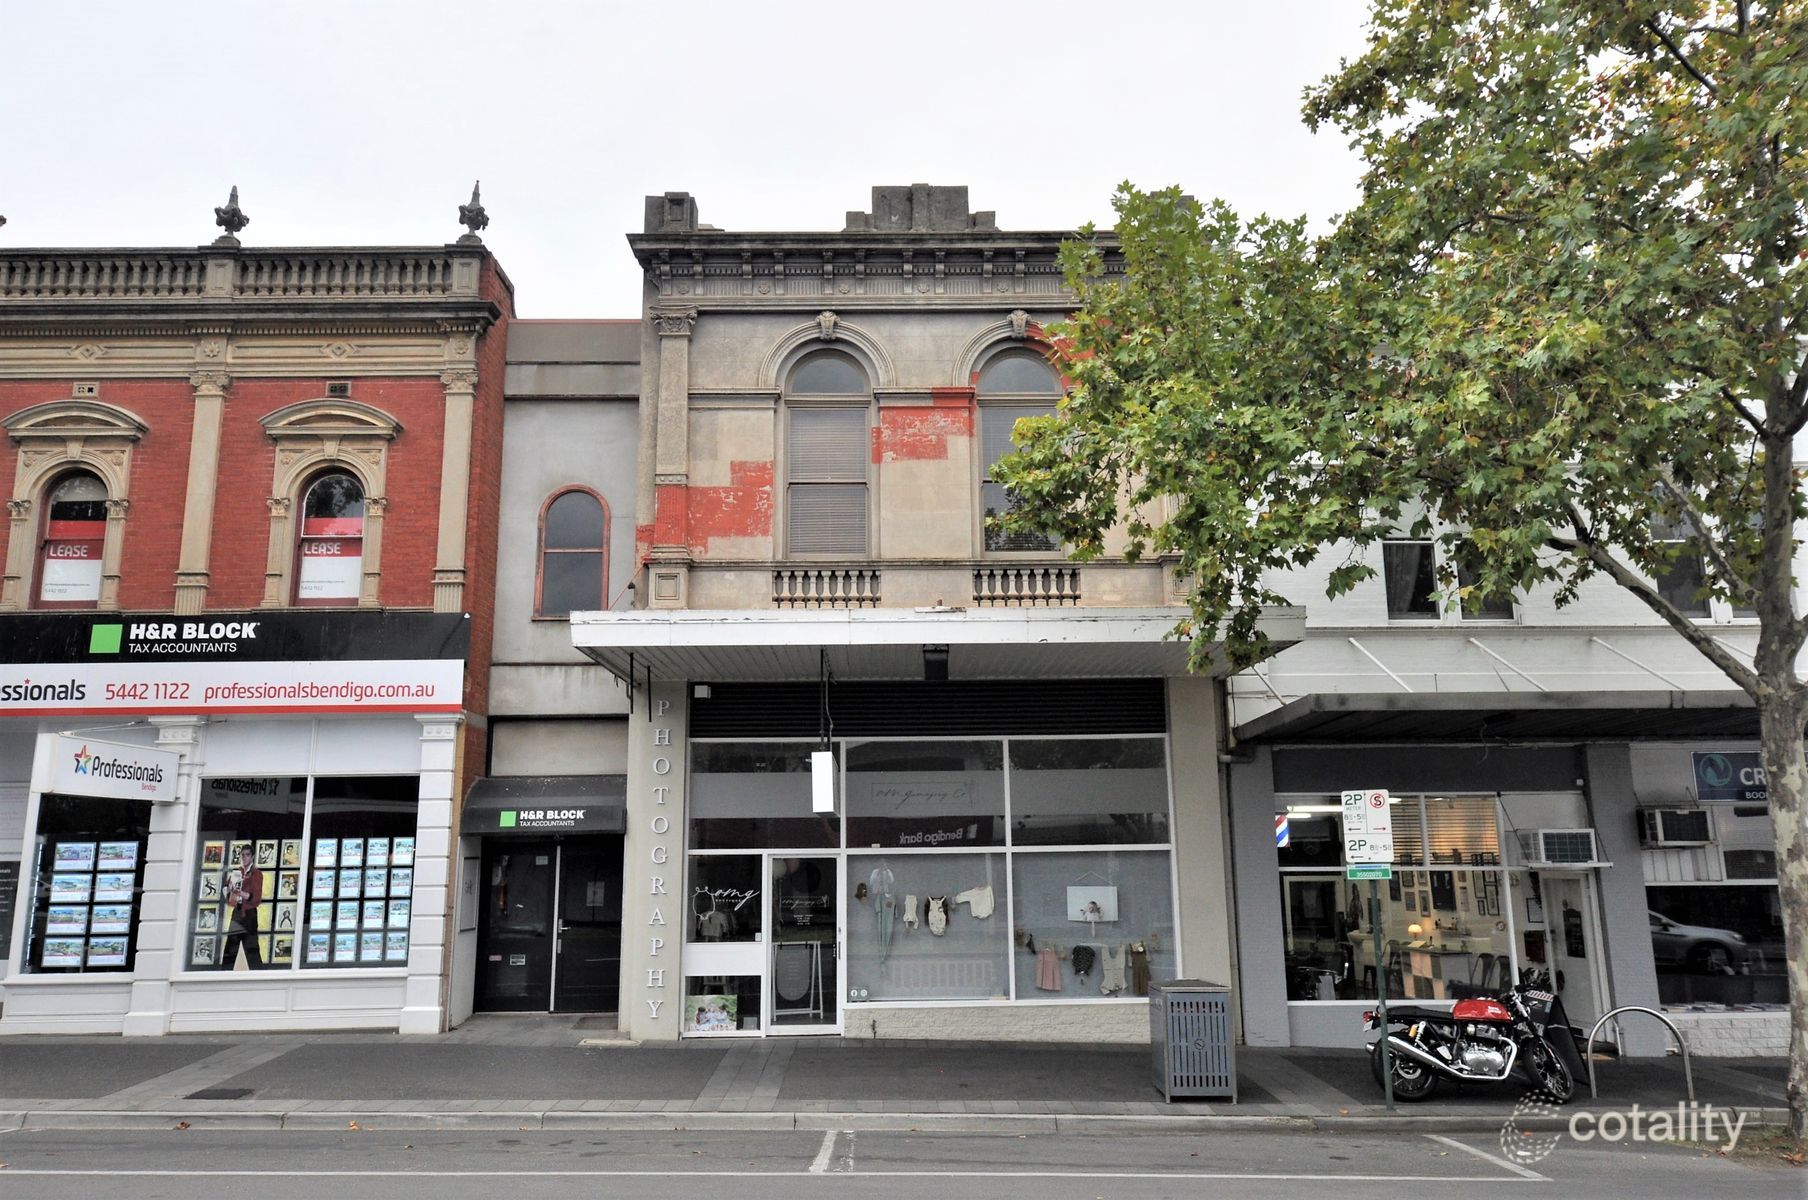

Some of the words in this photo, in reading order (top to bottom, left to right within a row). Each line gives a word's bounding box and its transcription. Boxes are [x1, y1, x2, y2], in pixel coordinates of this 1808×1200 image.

[50, 545, 88, 557] LEASE
[304, 542, 341, 554] LEASE
[129, 623, 177, 640] H&R
[183, 622, 257, 639] BLOCK
[129, 643, 150, 653] TAX
[151, 643, 237, 653] ACCOUNTANTS
[0, 679, 86, 701] ssionals
[105, 683, 149, 700] 5442
[153, 682, 191, 700] 1122
[204, 682, 435, 703] professionalsbendigo.com.au
[91, 756, 163, 783] Professionals
[1344, 794, 1363, 805] 2P
[1745, 791, 1768, 799] BOO
[520, 810, 544, 820] H&R
[546, 810, 585, 819] BLOCK
[1348, 839, 1367, 851] 2P
[647, 700, 671, 1019] PHOTOGRAPHY
